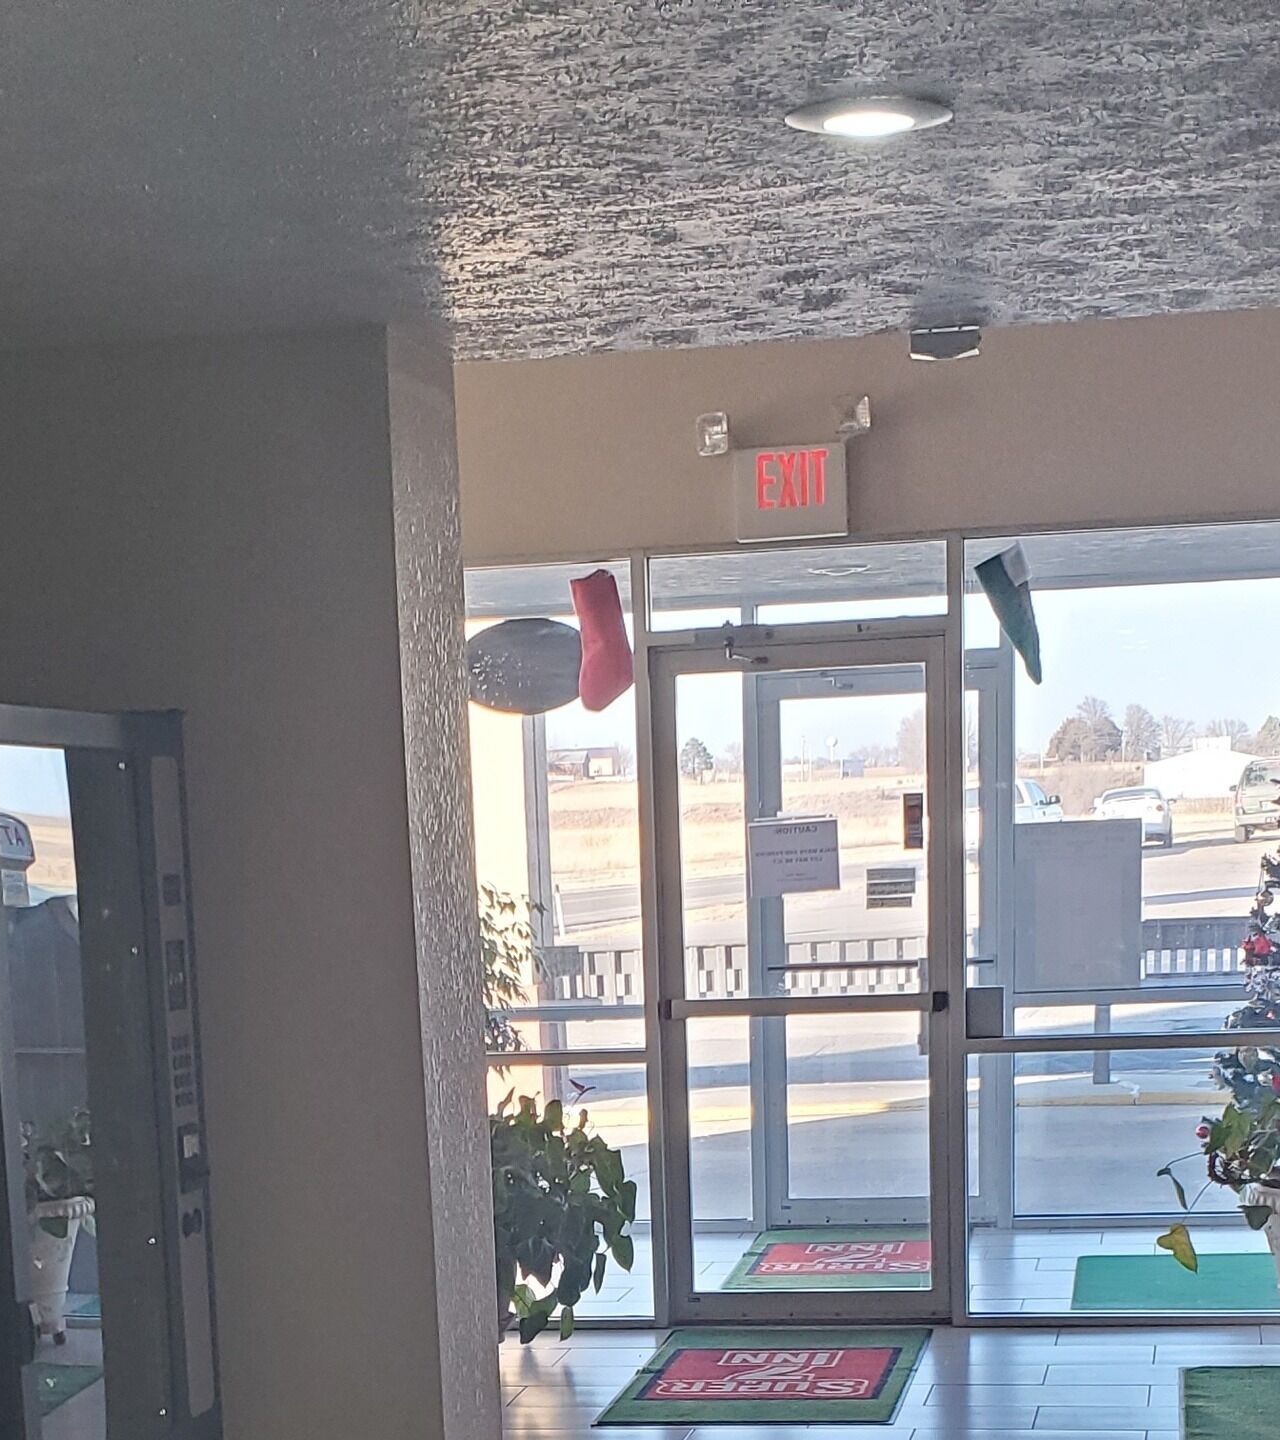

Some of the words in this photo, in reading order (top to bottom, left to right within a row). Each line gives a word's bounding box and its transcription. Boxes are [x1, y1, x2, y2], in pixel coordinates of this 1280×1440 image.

[756, 448, 829, 510] EXIT
[815, 1243, 895, 1253] INN
[730, 1352, 829, 1365] INN
[736, 1363, 804, 1380] 7
[670, 1380, 856, 1394] SUPER
